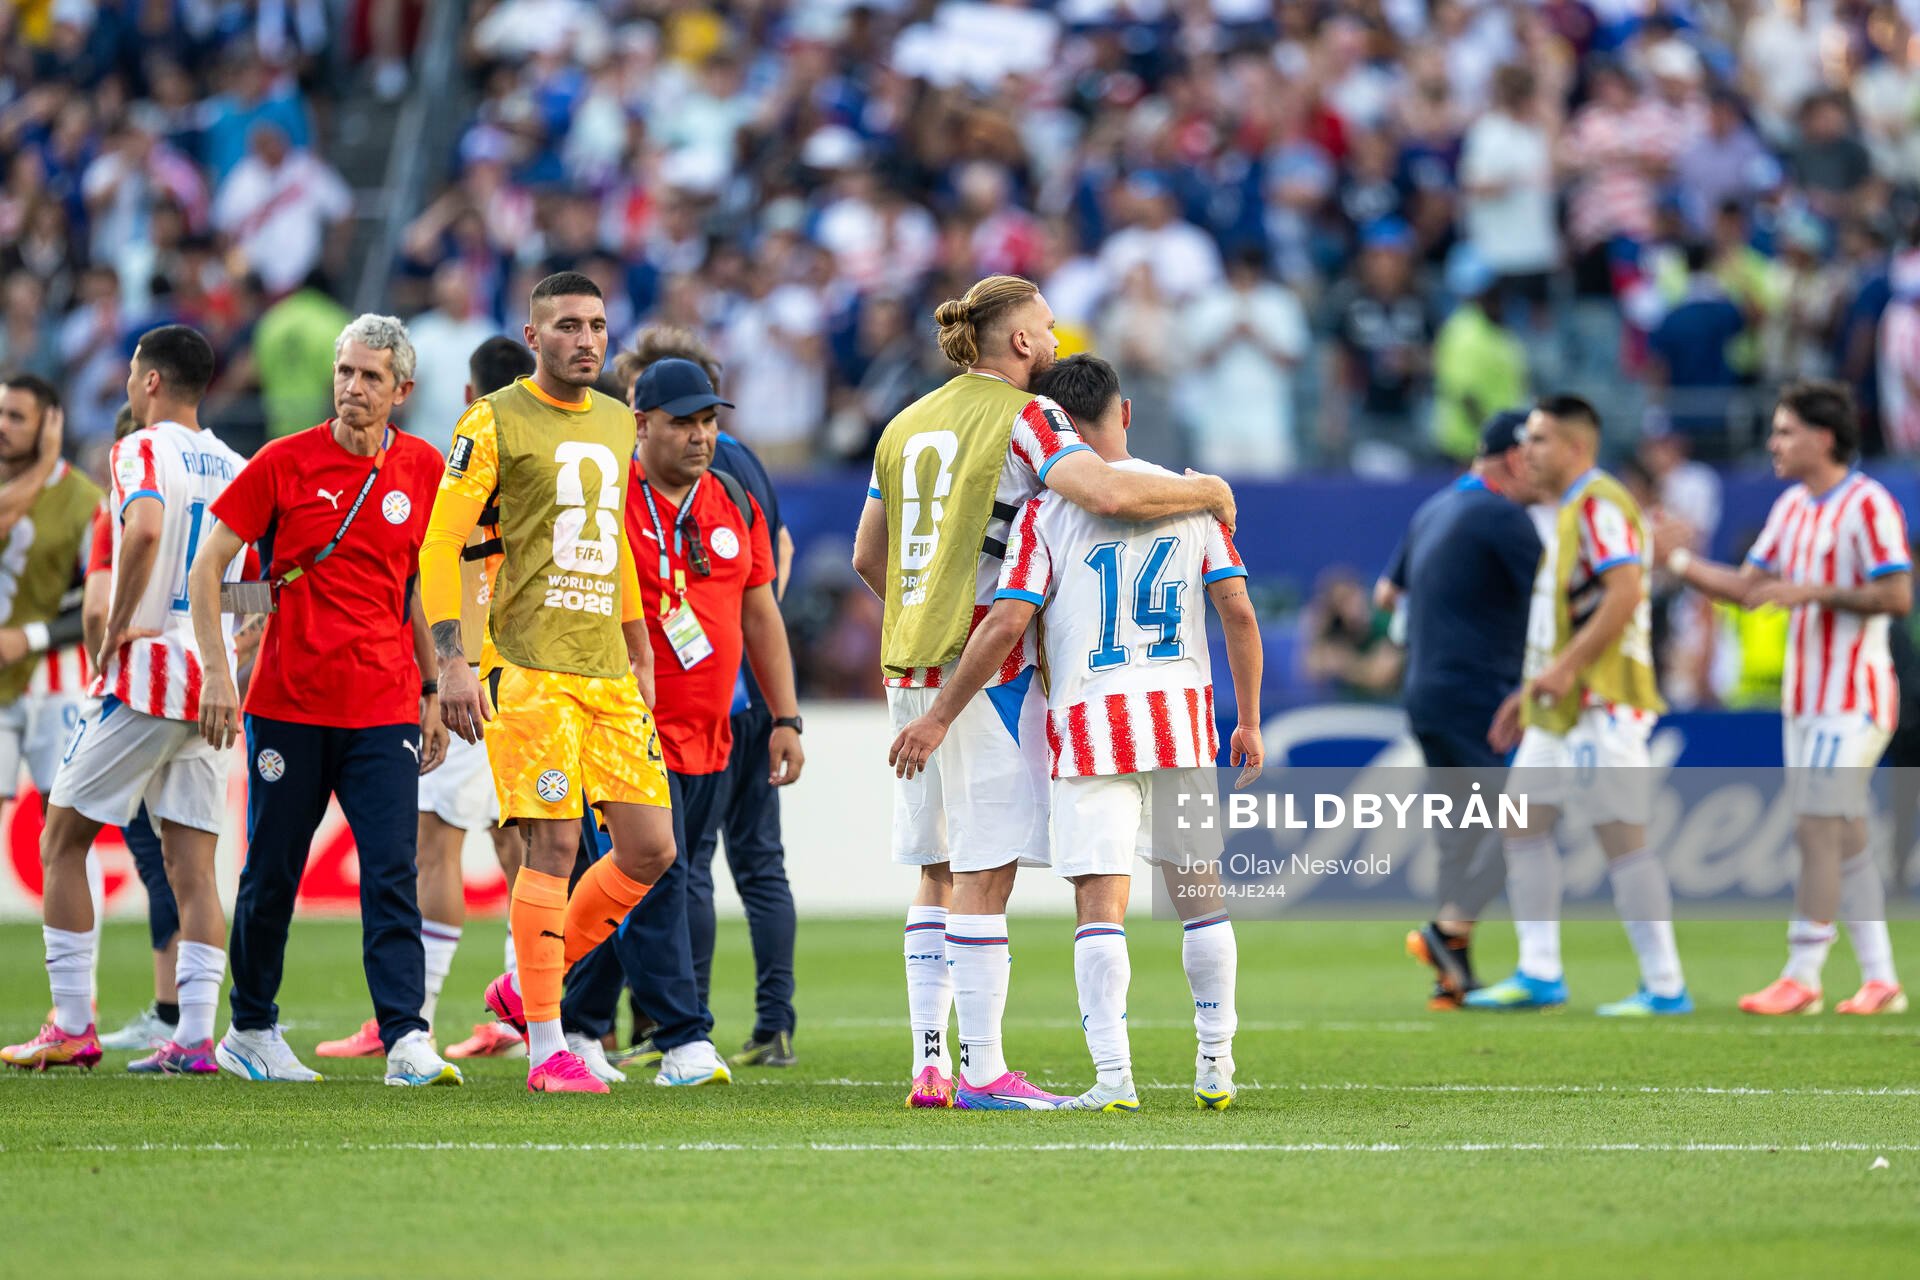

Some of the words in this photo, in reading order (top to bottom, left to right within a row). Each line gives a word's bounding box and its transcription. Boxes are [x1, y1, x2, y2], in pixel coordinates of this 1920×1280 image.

[575, 546, 604, 563] FIFA
[547, 575, 594, 591] WORLD
[594, 579, 616, 595] CUP
[543, 588, 614, 617] 2026
[1083, 536, 1188, 673] 14
